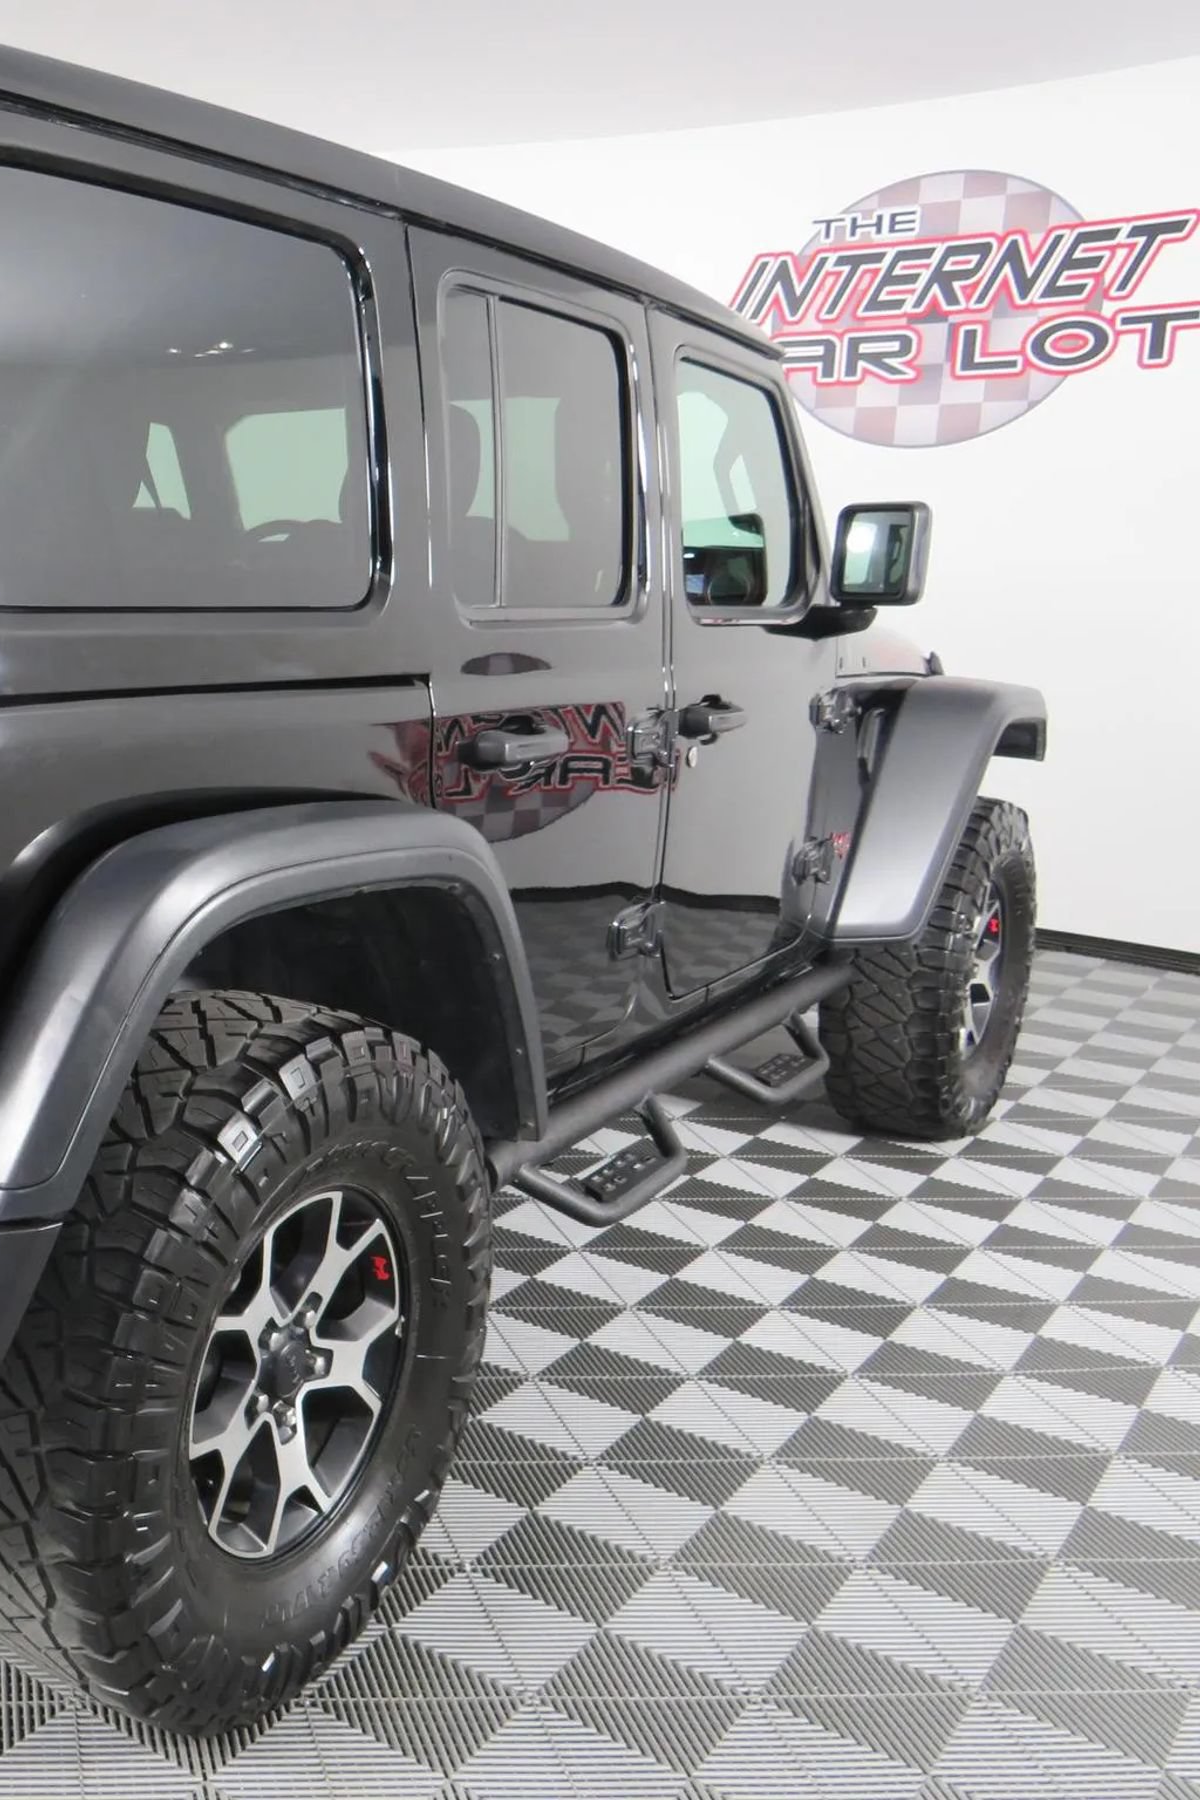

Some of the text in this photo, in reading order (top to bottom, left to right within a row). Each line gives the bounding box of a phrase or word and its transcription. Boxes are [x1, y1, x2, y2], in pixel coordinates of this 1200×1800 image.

[811, 207, 919, 239] THE
[731, 211, 1196, 321] INTERNET
[779, 304, 1200, 382] AR LOT
